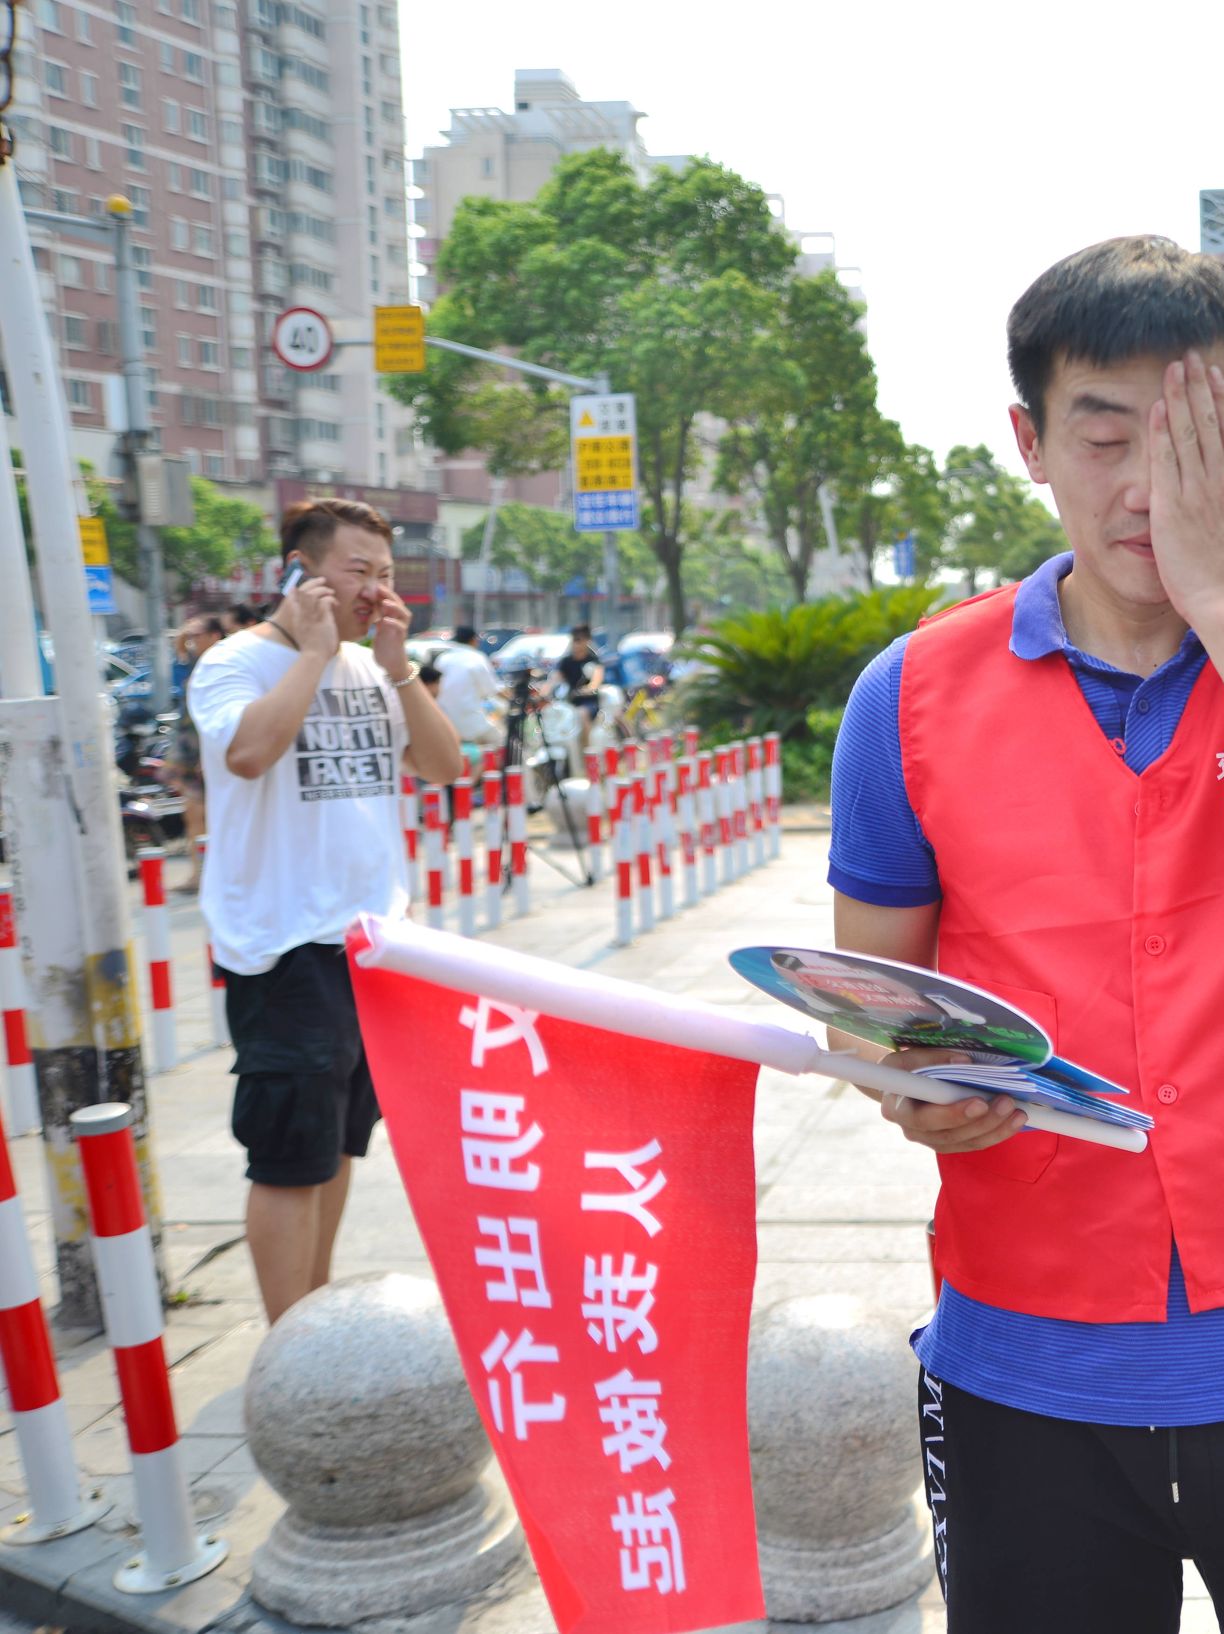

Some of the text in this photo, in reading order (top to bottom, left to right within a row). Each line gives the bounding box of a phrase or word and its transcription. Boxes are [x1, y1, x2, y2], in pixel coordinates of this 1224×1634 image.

[331, 688, 383, 716] THE
[304, 719, 390, 751] NORTH
[308, 754, 378, 787] FACE
